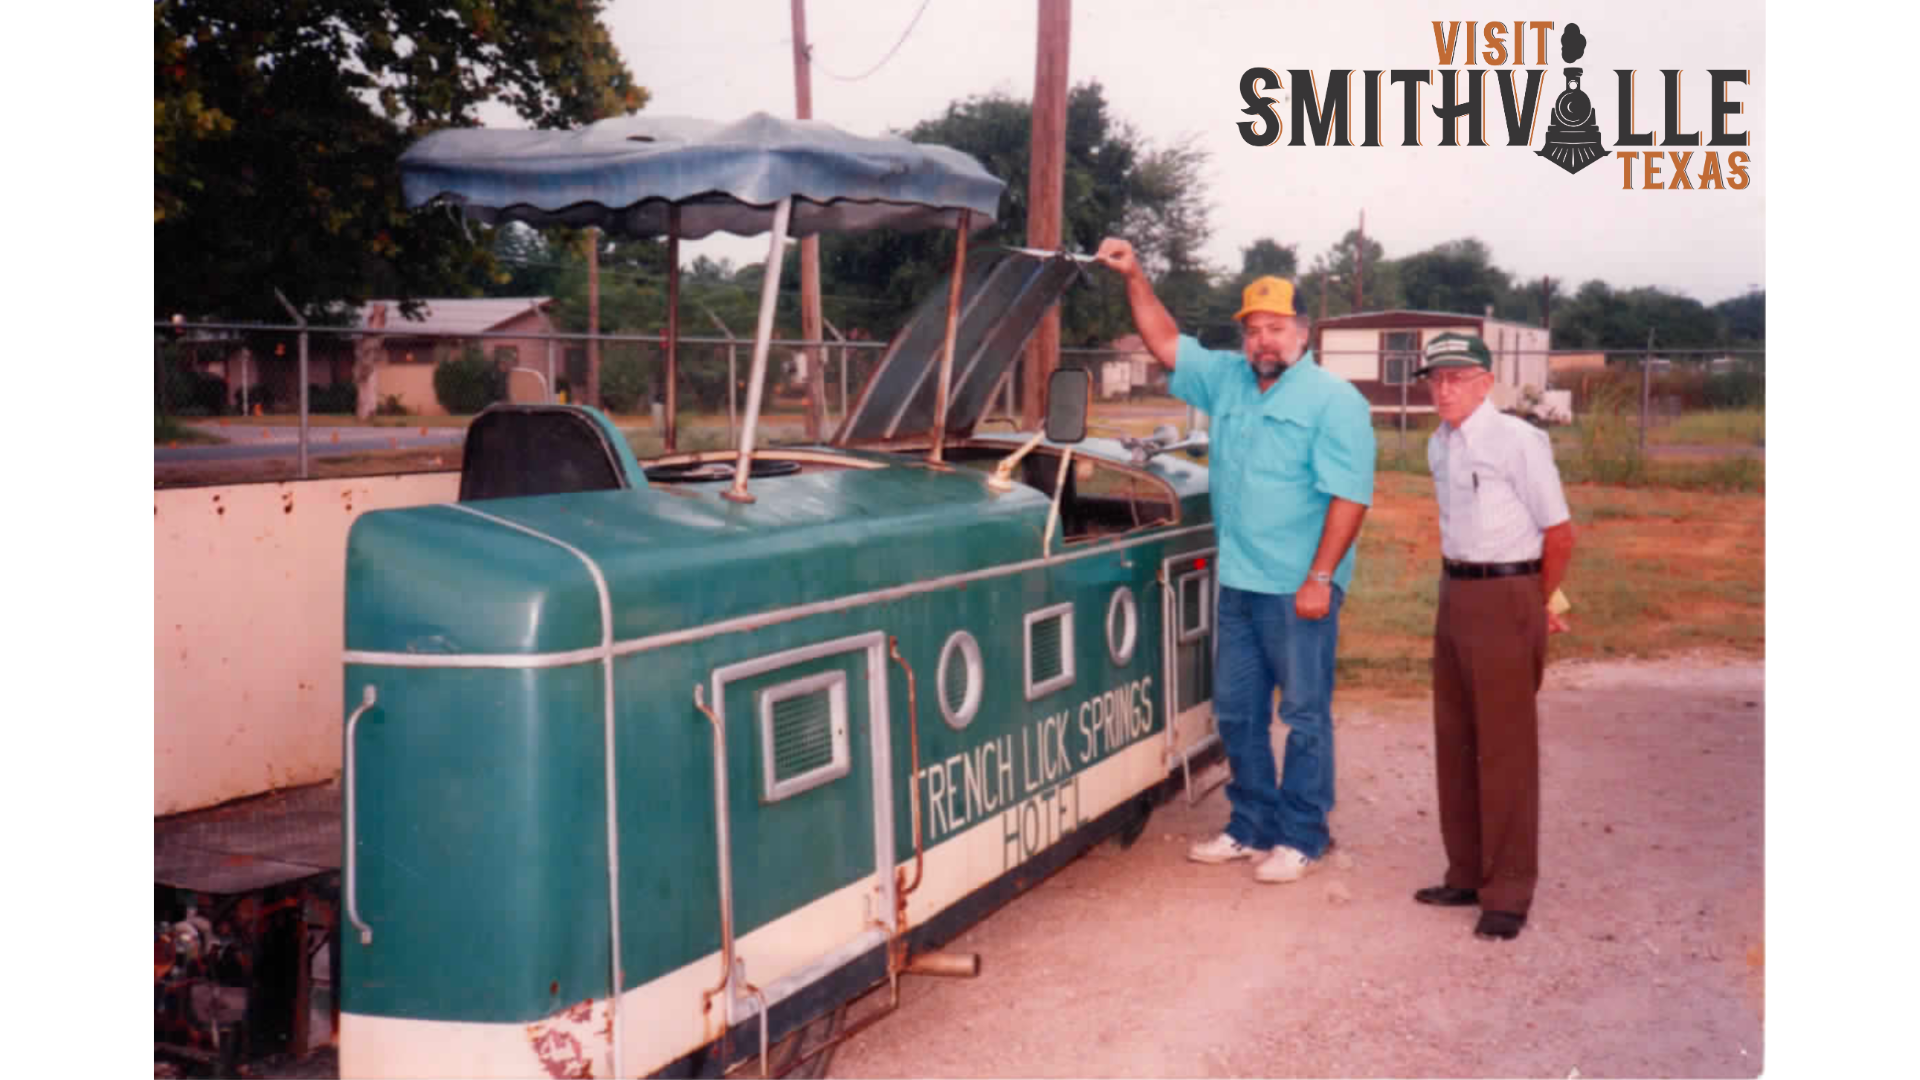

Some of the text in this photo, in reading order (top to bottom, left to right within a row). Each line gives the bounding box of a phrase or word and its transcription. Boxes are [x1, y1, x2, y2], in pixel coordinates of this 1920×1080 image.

[909, 676, 1153, 849] FRENCH LICK SPRINGS
[1003, 773, 1091, 869] HOTEL
